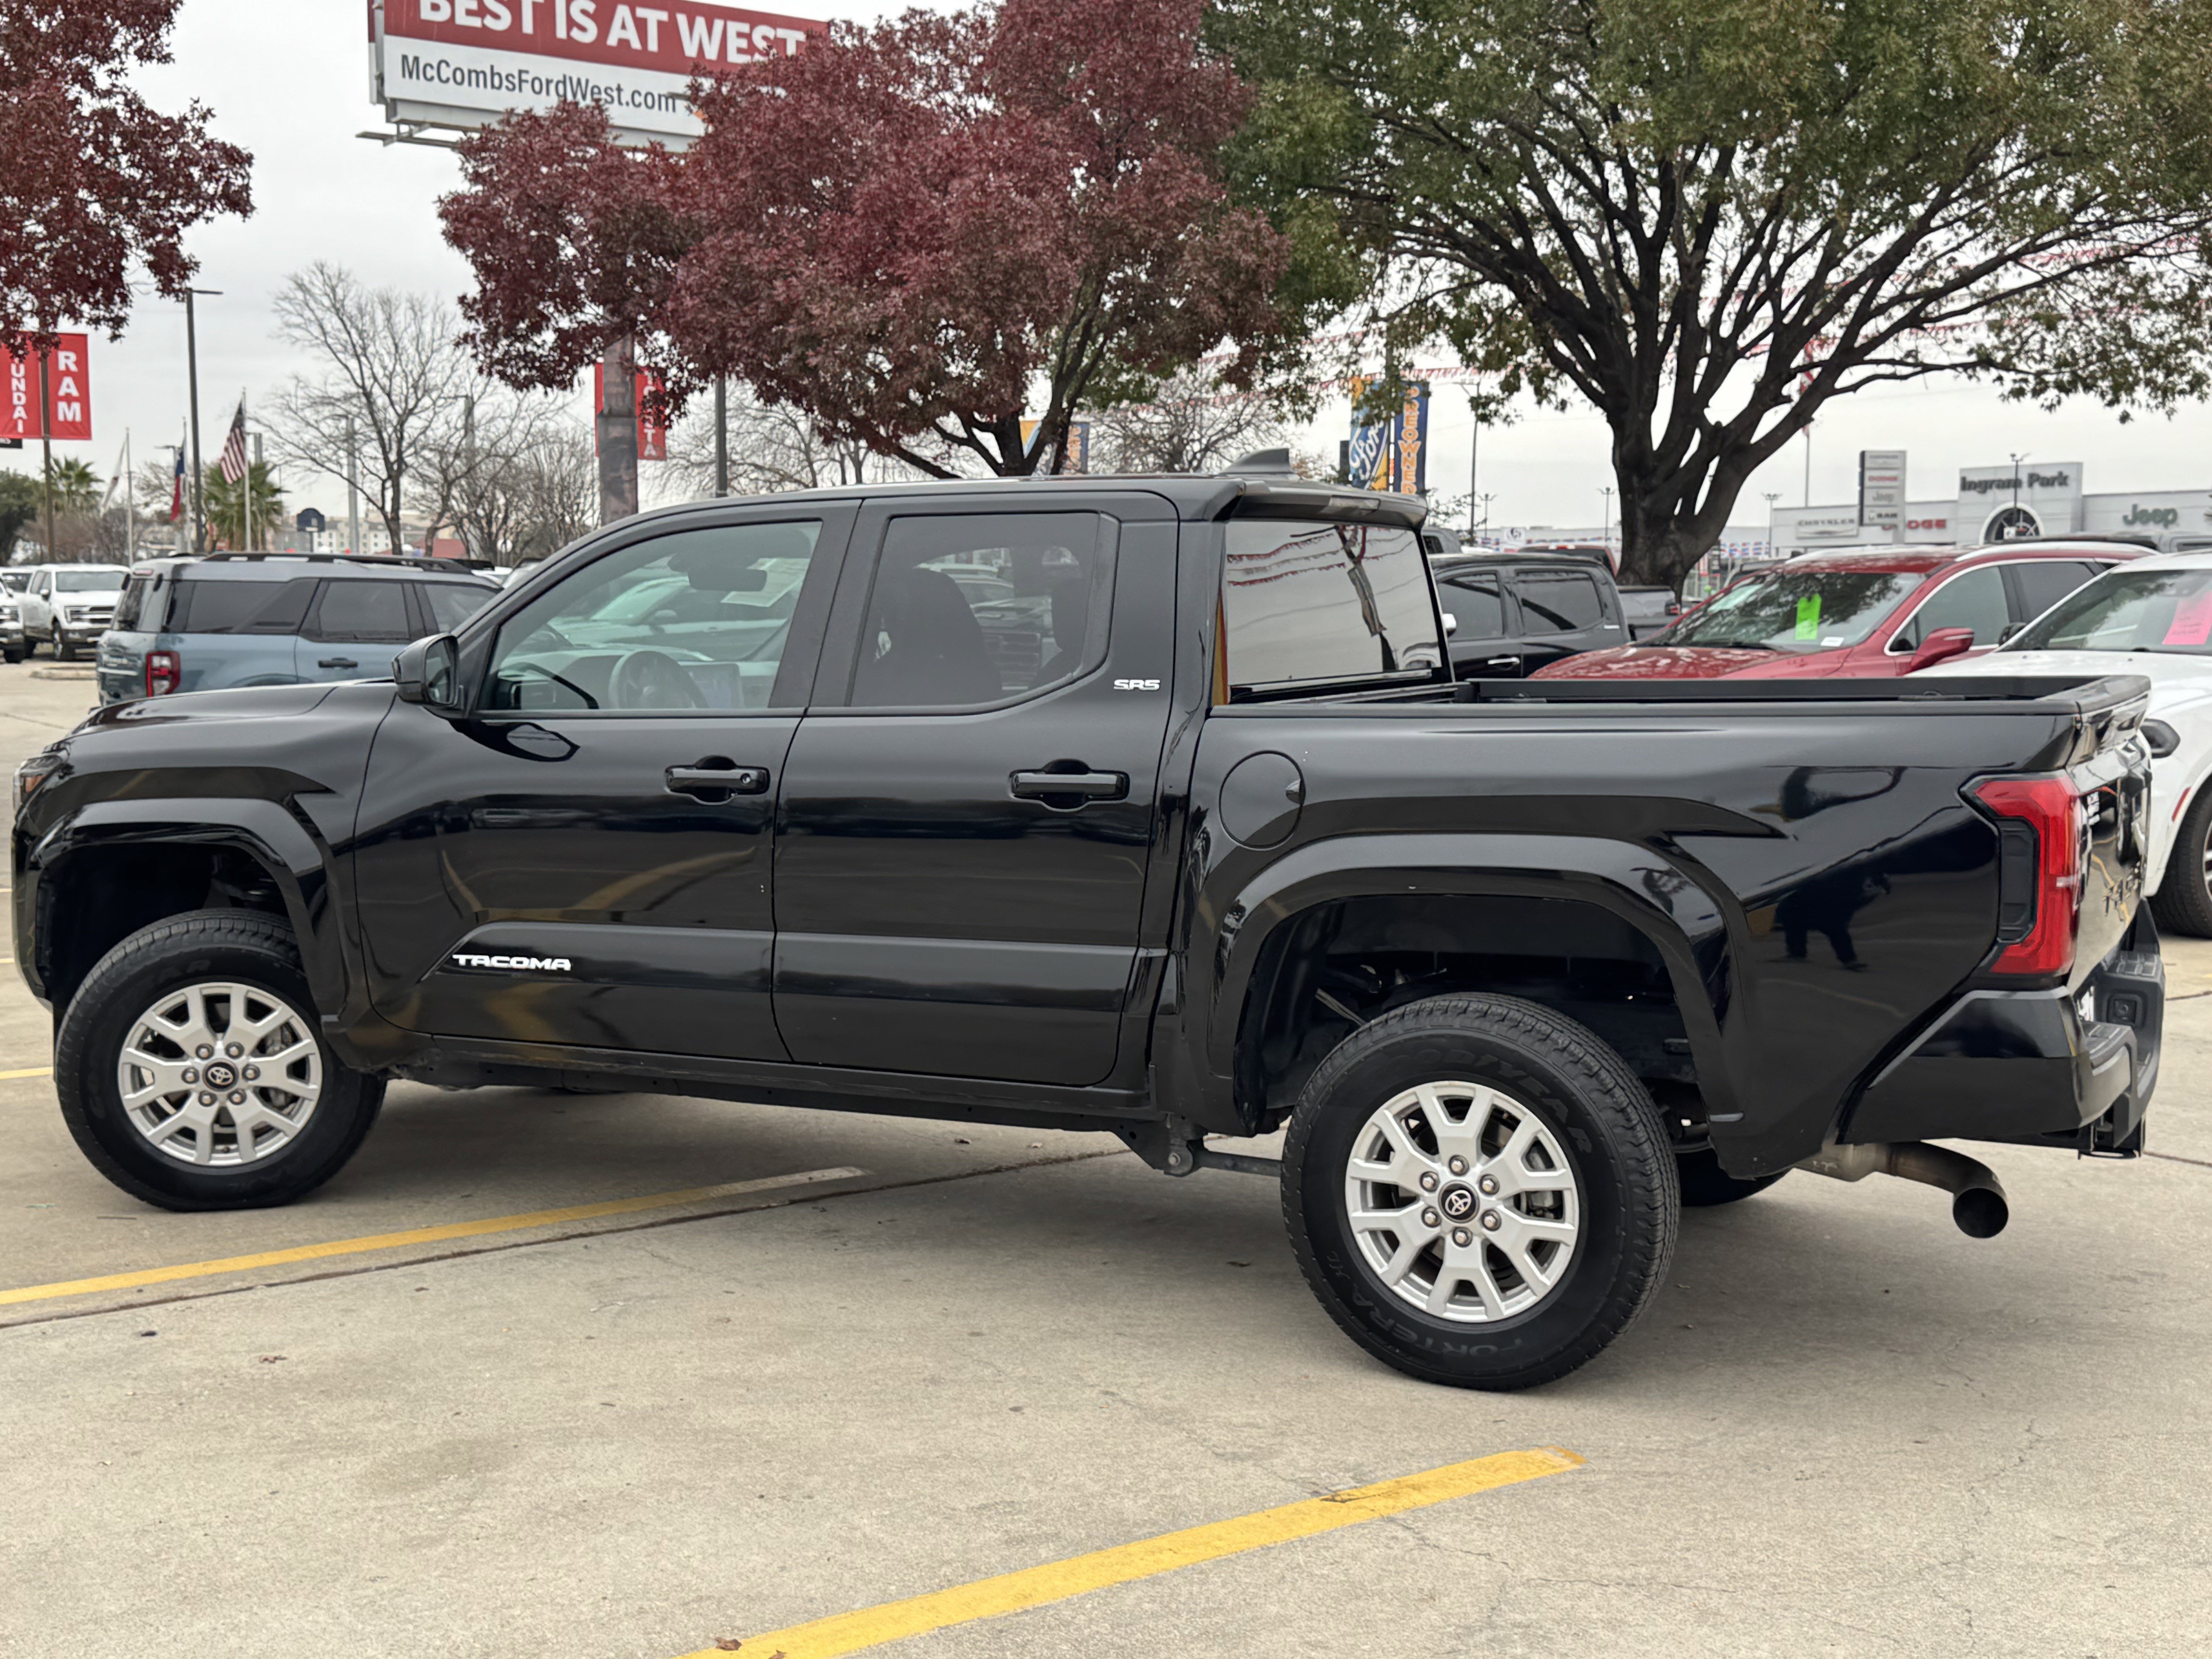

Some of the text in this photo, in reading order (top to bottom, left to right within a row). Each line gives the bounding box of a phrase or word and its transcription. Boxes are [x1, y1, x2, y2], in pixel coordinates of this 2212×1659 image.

[555, 0, 598, 43] IS
[606, 4, 669, 53] AT
[675, 12, 806, 64] WEST
[401, 54, 676, 112] McCombsFordWest.com
[10, 357, 27, 433] UNDAI
[57, 350, 82, 422] RAM
[1960, 471, 2068, 494] Ingram Park
[2123, 504, 2178, 528] Jeep
[1113, 679, 1160, 690] SR5
[452, 954, 571, 971] TACOMA
